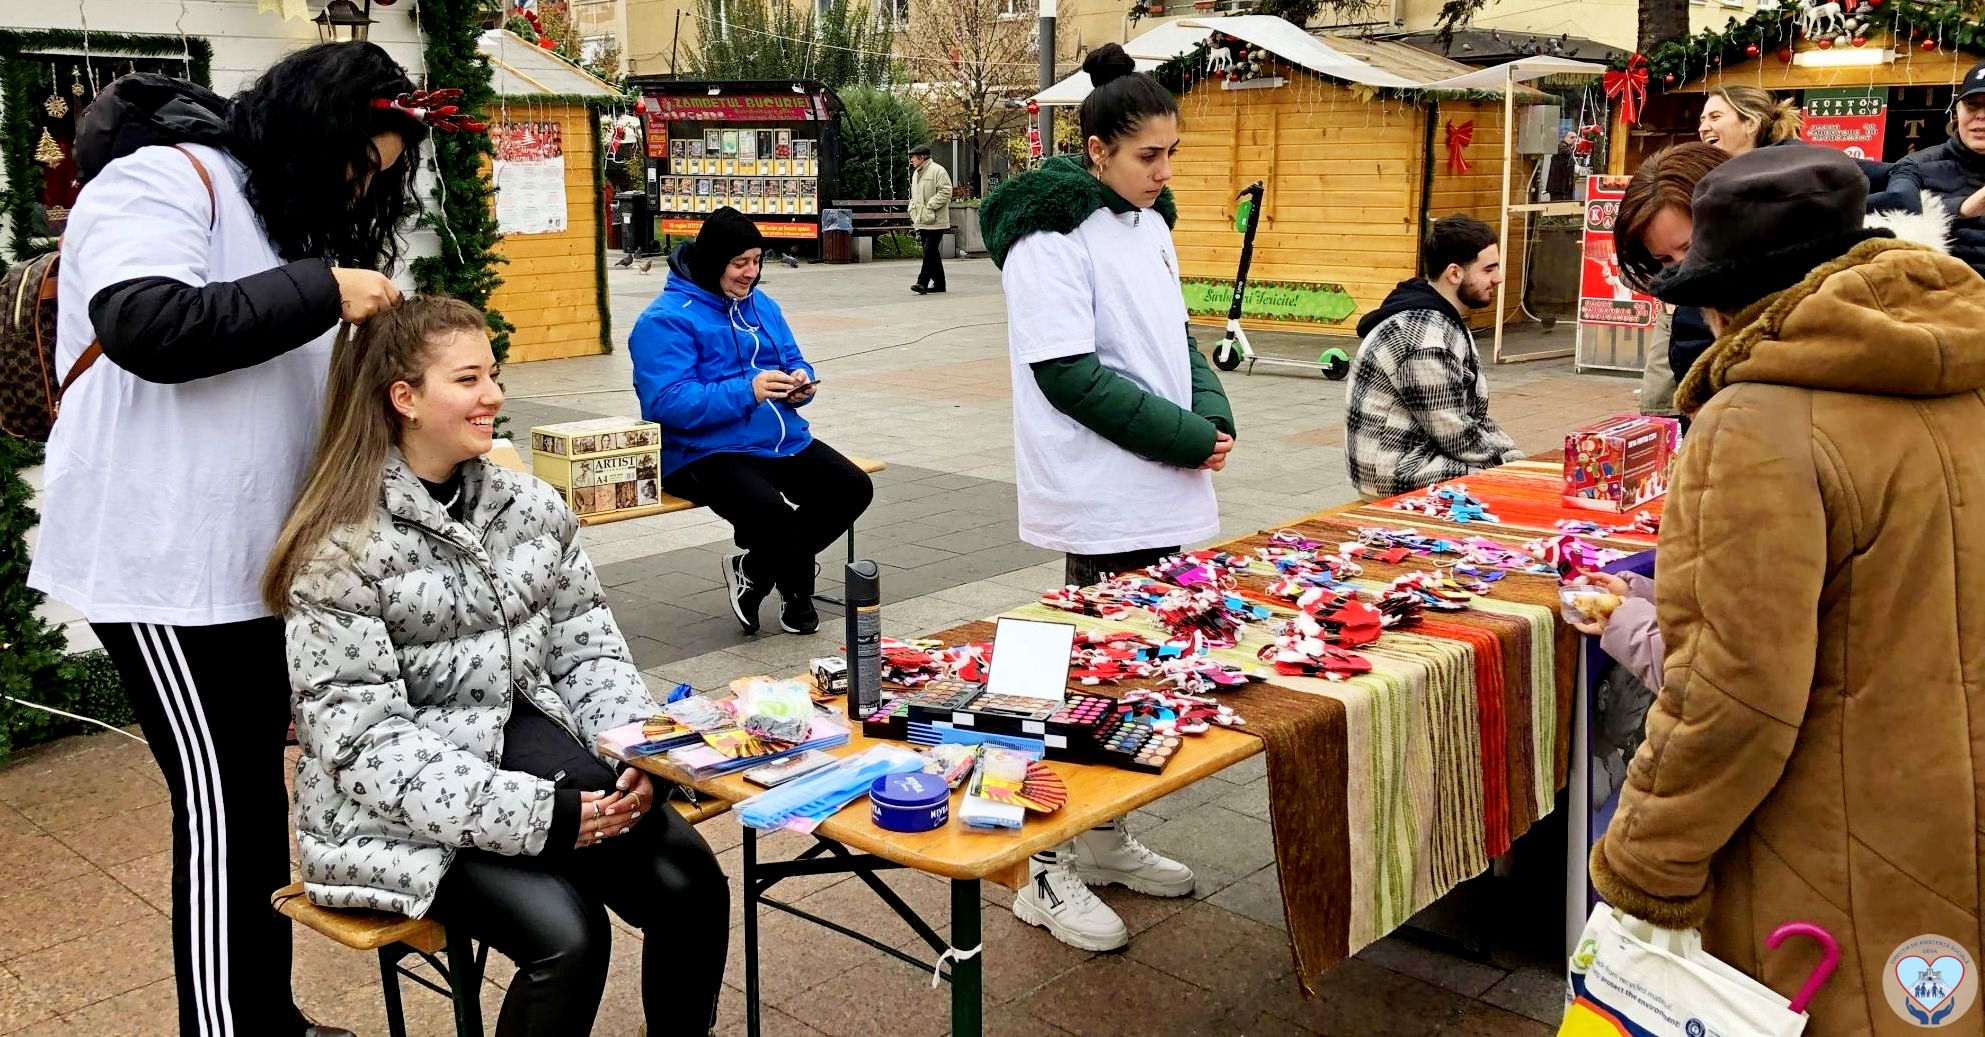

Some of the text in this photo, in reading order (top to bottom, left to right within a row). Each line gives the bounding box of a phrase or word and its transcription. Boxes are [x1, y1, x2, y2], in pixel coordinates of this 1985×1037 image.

[596, 455, 635, 470] ARTIST
[597, 475, 607, 485] A4
[1601, 976, 1624, 995] protect
[1625, 989, 1637, 1000] the
[1619, 976, 1647, 995] recycled
